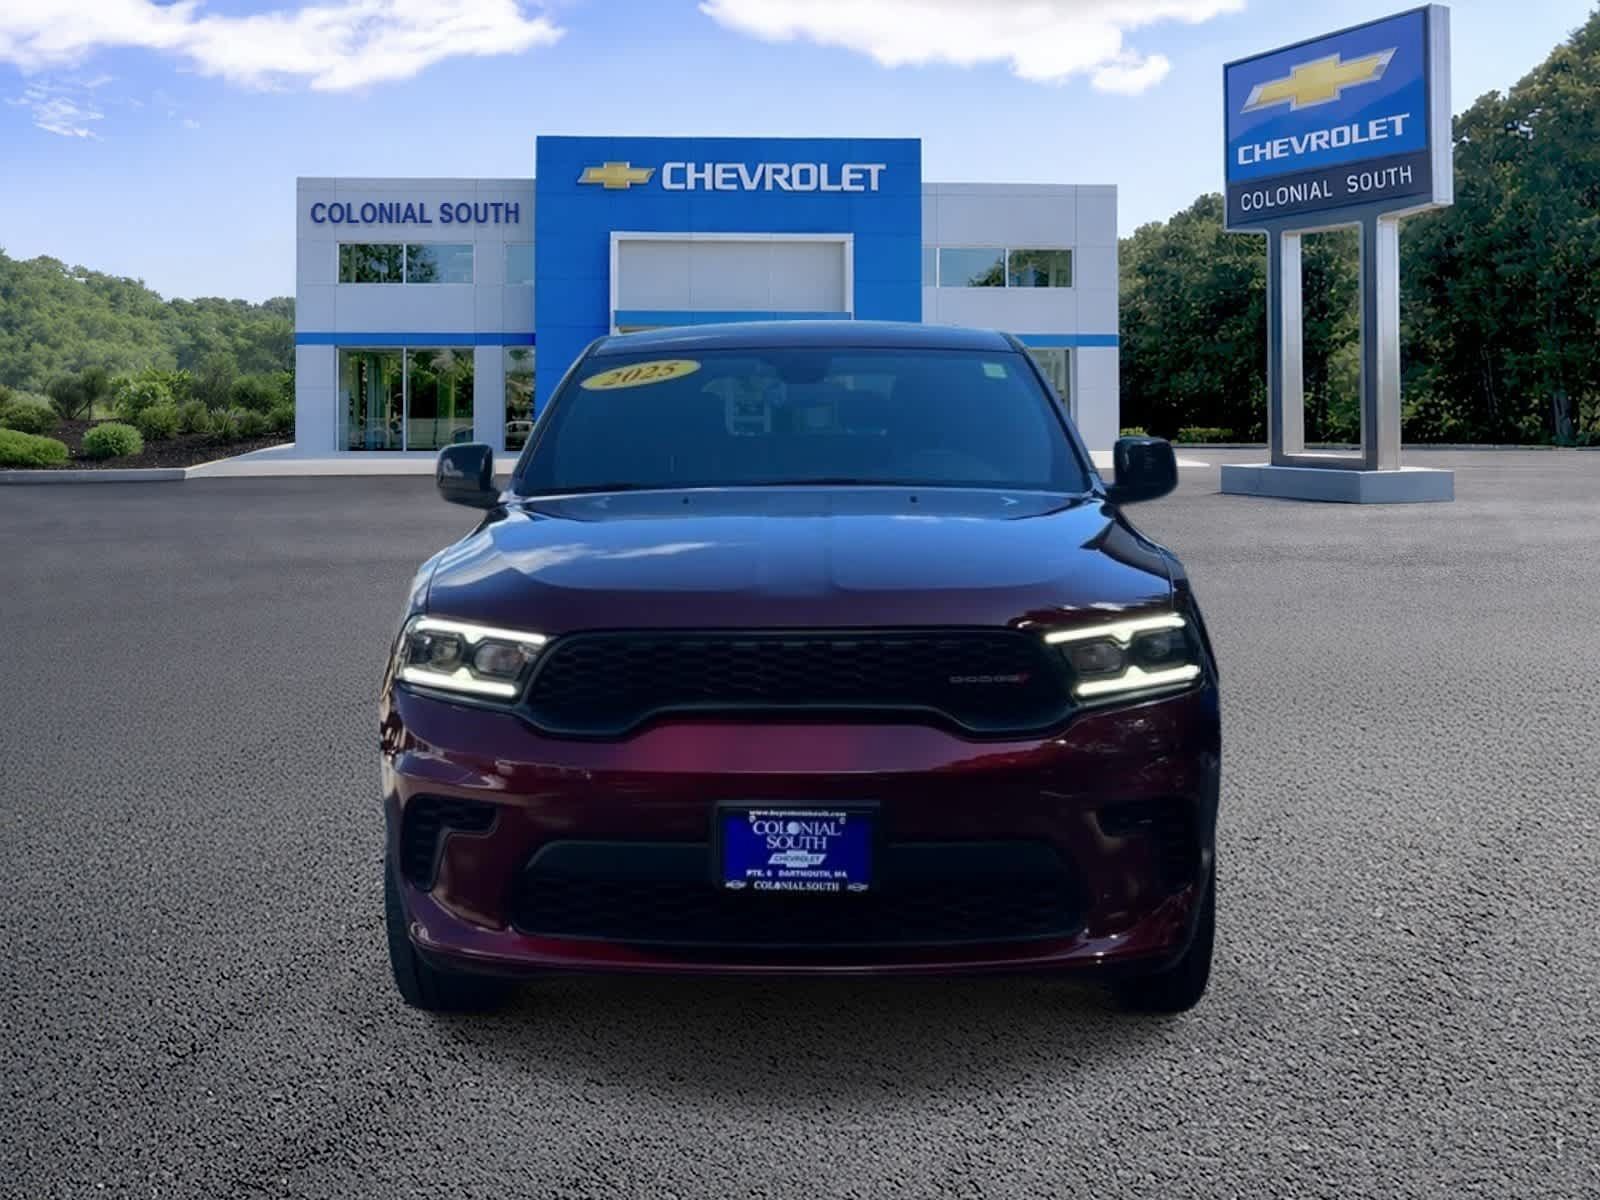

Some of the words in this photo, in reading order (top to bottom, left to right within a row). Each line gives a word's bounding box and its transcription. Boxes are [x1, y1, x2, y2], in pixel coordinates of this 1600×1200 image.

[1238, 113, 1410, 165] CHEVROLET
[662, 162, 887, 191] CHEVROLET
[1241, 180, 1333, 211] COLONIAL
[1347, 165, 1413, 194] SOUTH
[311, 202, 432, 224] COLONIAL
[439, 202, 519, 224] SOUTH
[601, 362, 681, 386] 2025
[752, 820, 842, 836] COLONIAL
[766, 836, 827, 849] SOUTH
